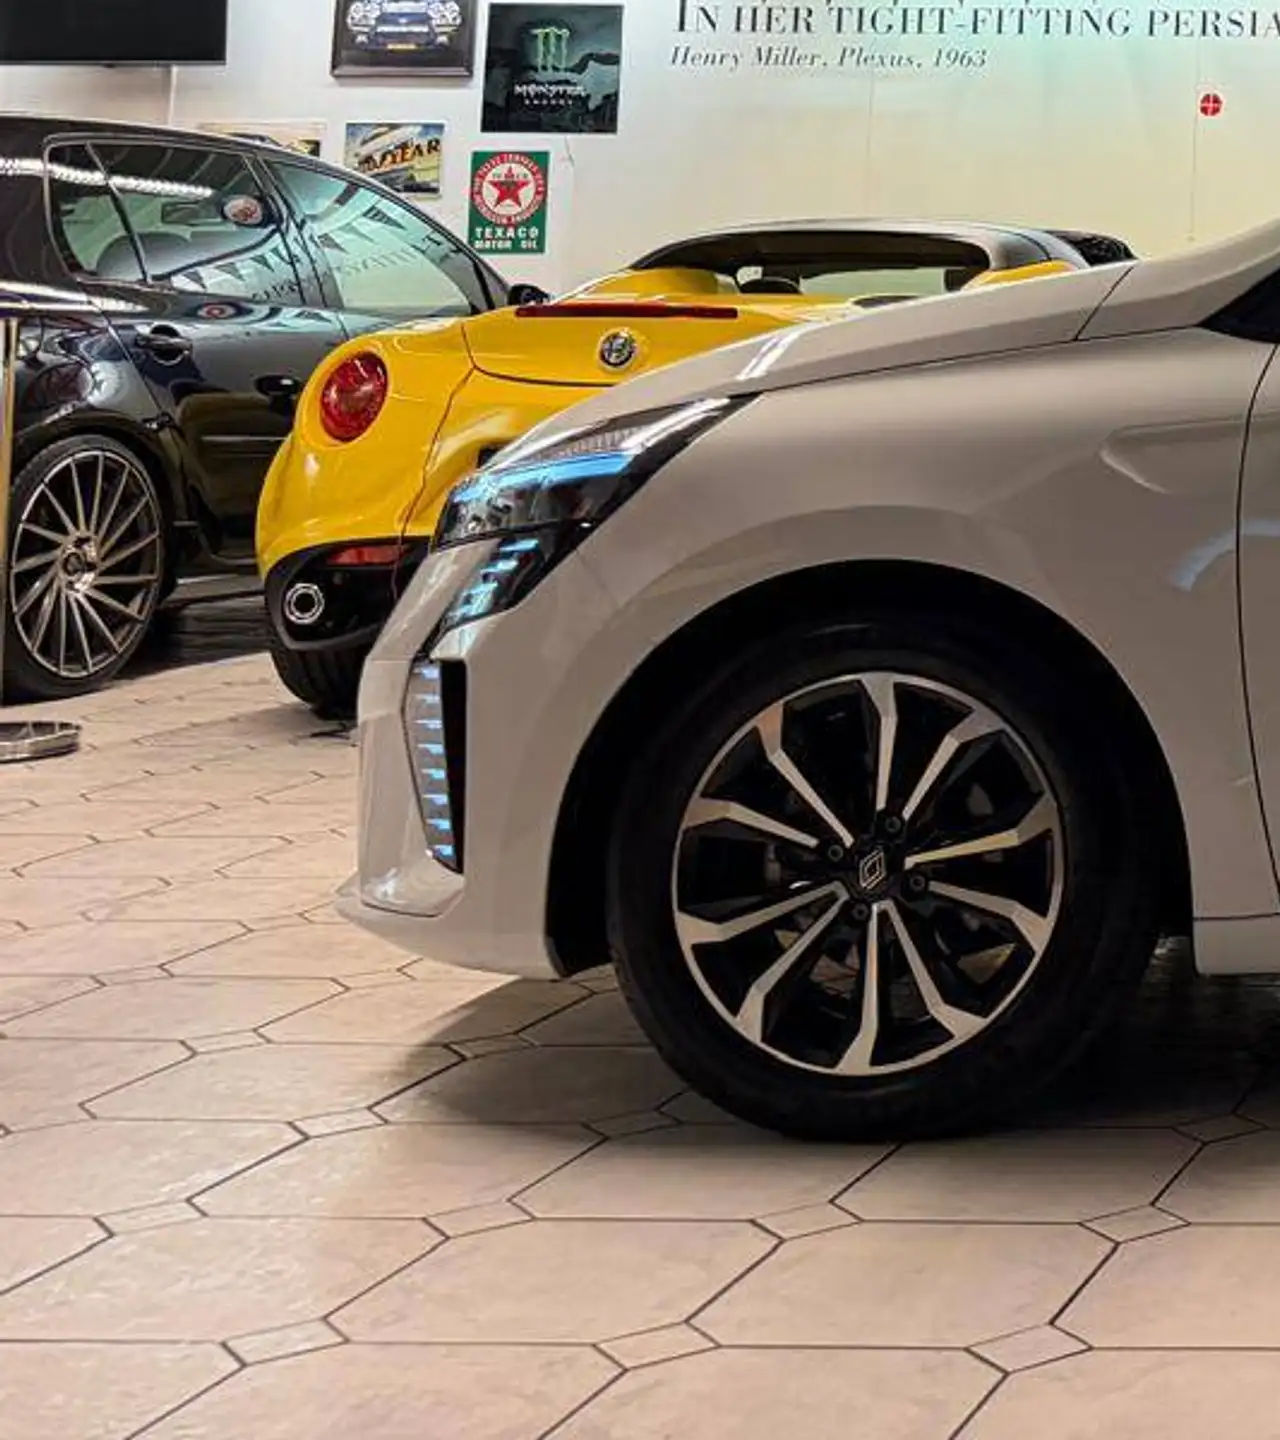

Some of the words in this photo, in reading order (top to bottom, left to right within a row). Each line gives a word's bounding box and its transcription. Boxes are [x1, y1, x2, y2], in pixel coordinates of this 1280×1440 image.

[734, 6, 815, 35] HER
[827, 6, 1131, 36] TIGHT-FITTING
[671, 46, 742, 72] Henry
[933, 48, 988, 69] 1963
[475, 227, 540, 239] TEXACO
